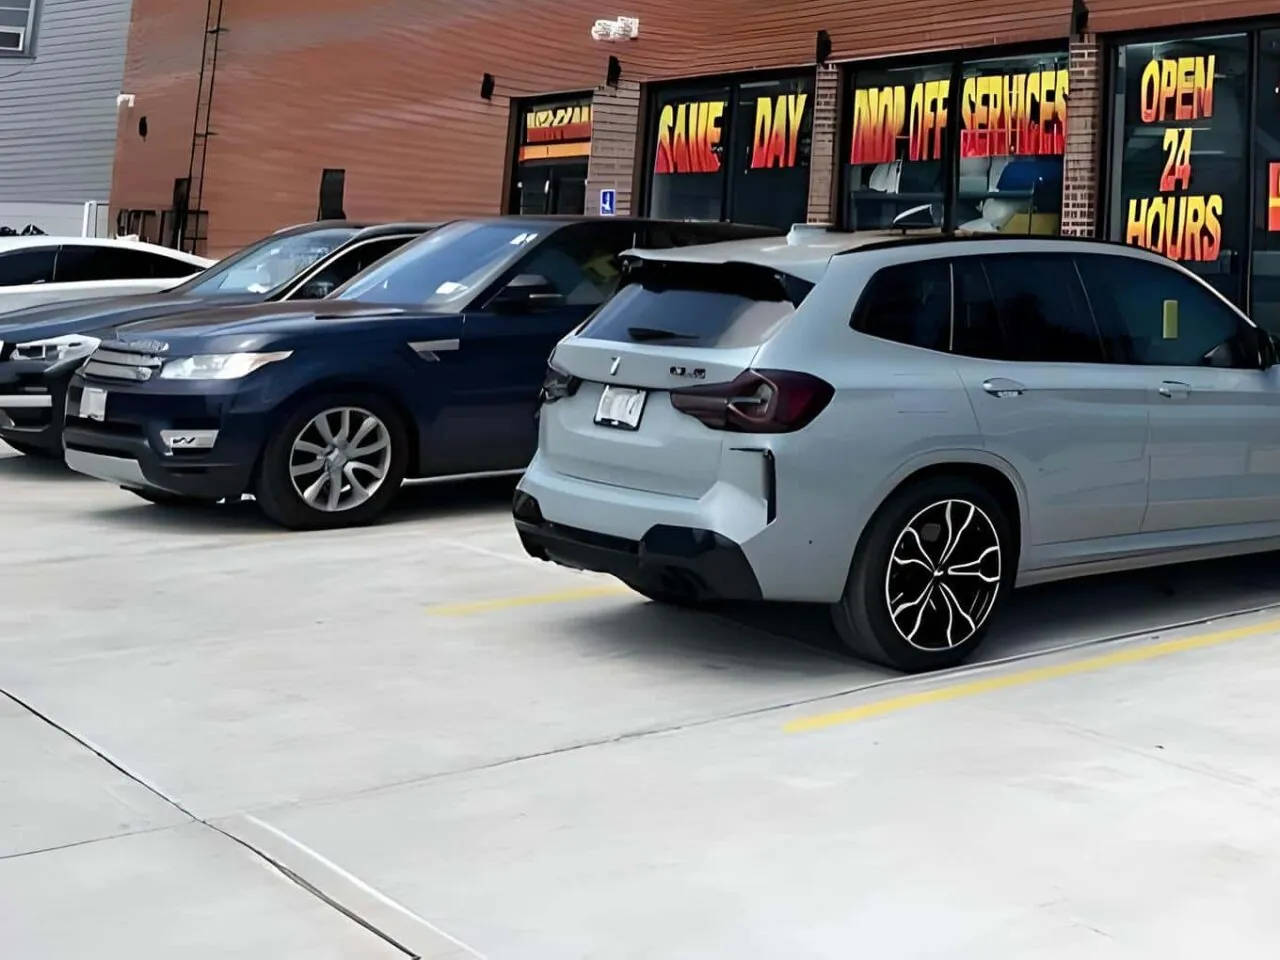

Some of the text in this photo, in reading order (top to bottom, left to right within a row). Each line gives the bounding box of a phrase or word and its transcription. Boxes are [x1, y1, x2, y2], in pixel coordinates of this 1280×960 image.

[909, 79, 950, 161] OFF
[960, 69, 1069, 158] SERVICES
[1141, 53, 1216, 123] OPEN
[751, 93, 808, 169] DAY
[1159, 127, 1193, 192] 24
[1126, 194, 1223, 262] HOURS
